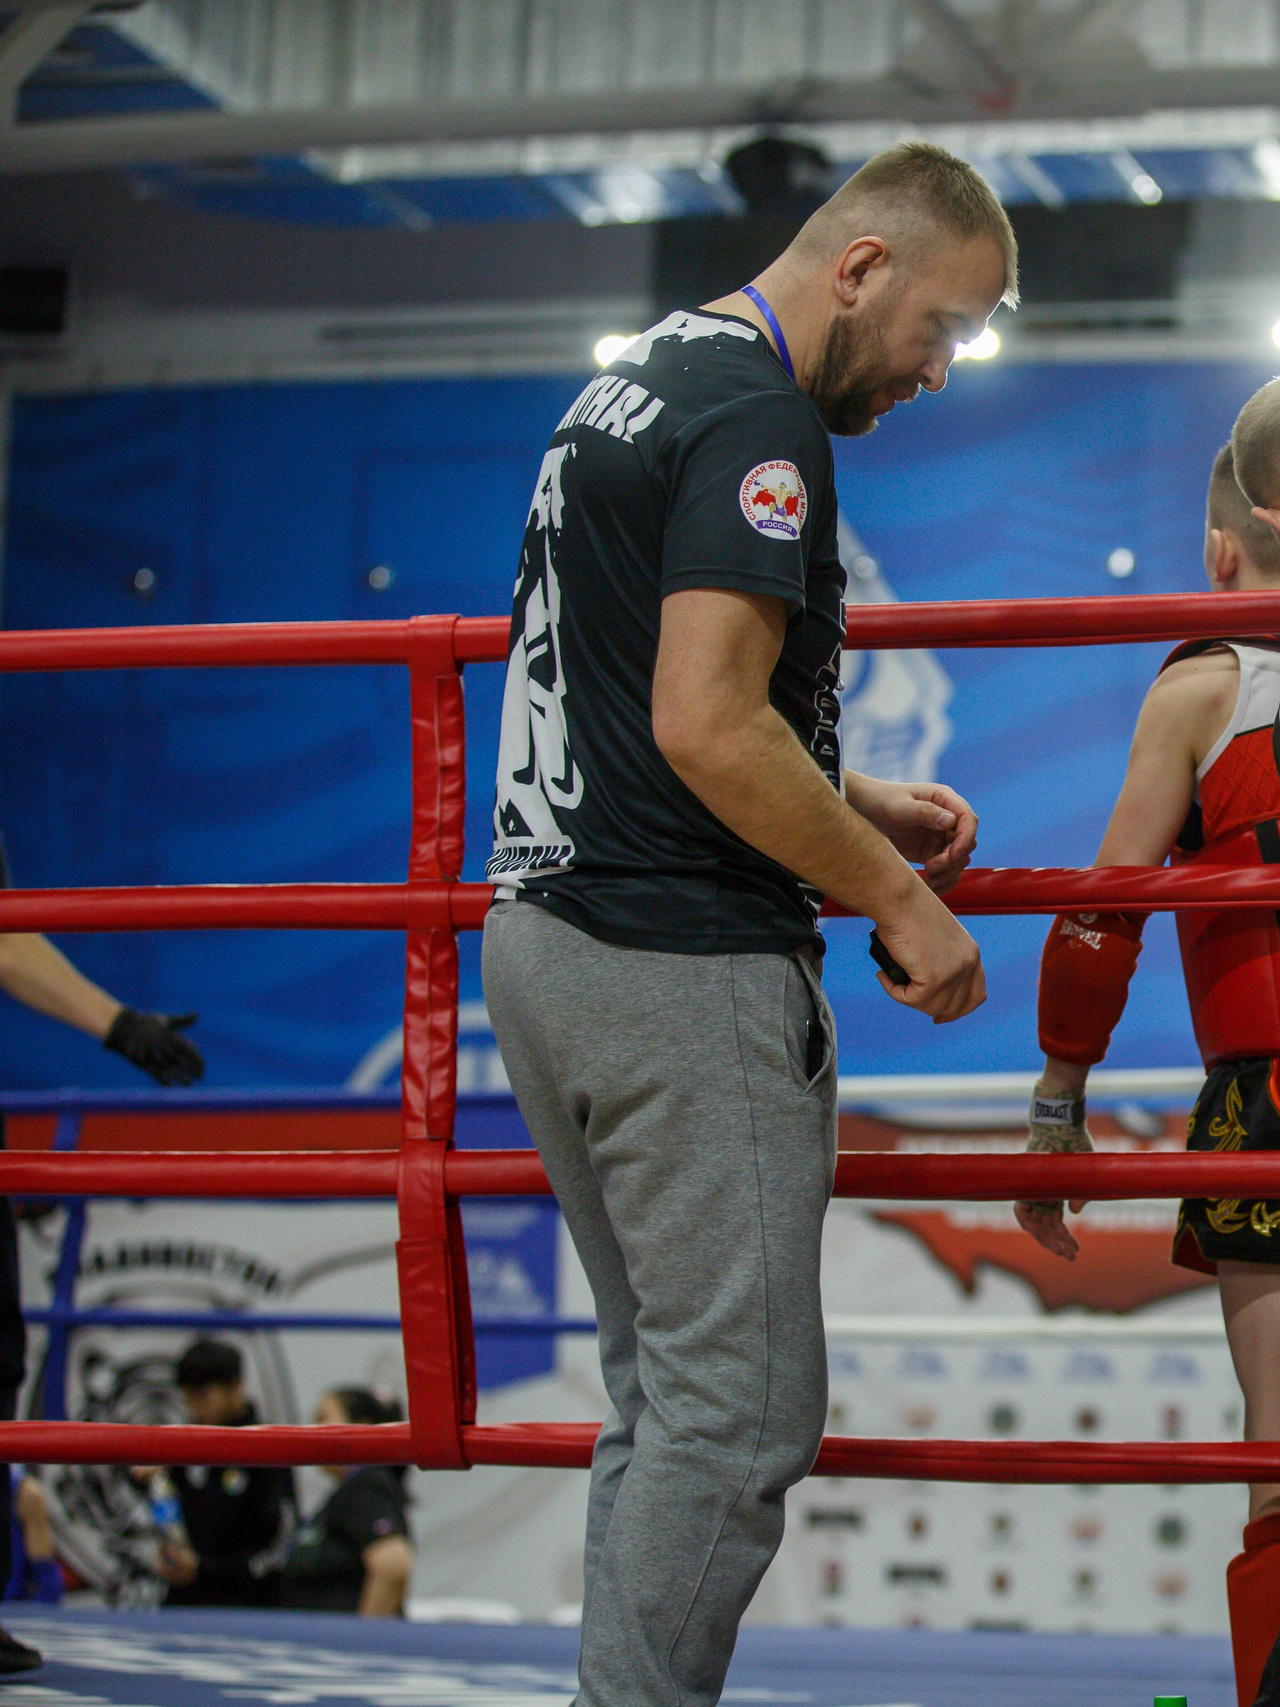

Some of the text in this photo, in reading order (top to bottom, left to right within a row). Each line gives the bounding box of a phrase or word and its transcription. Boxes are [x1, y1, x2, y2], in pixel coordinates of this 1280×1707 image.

[742, 465, 767, 521] СПОРТИВНАЯ
[762, 521, 793, 533] РОССИЯ
[1035, 1101, 1070, 1120] EVERLAST
